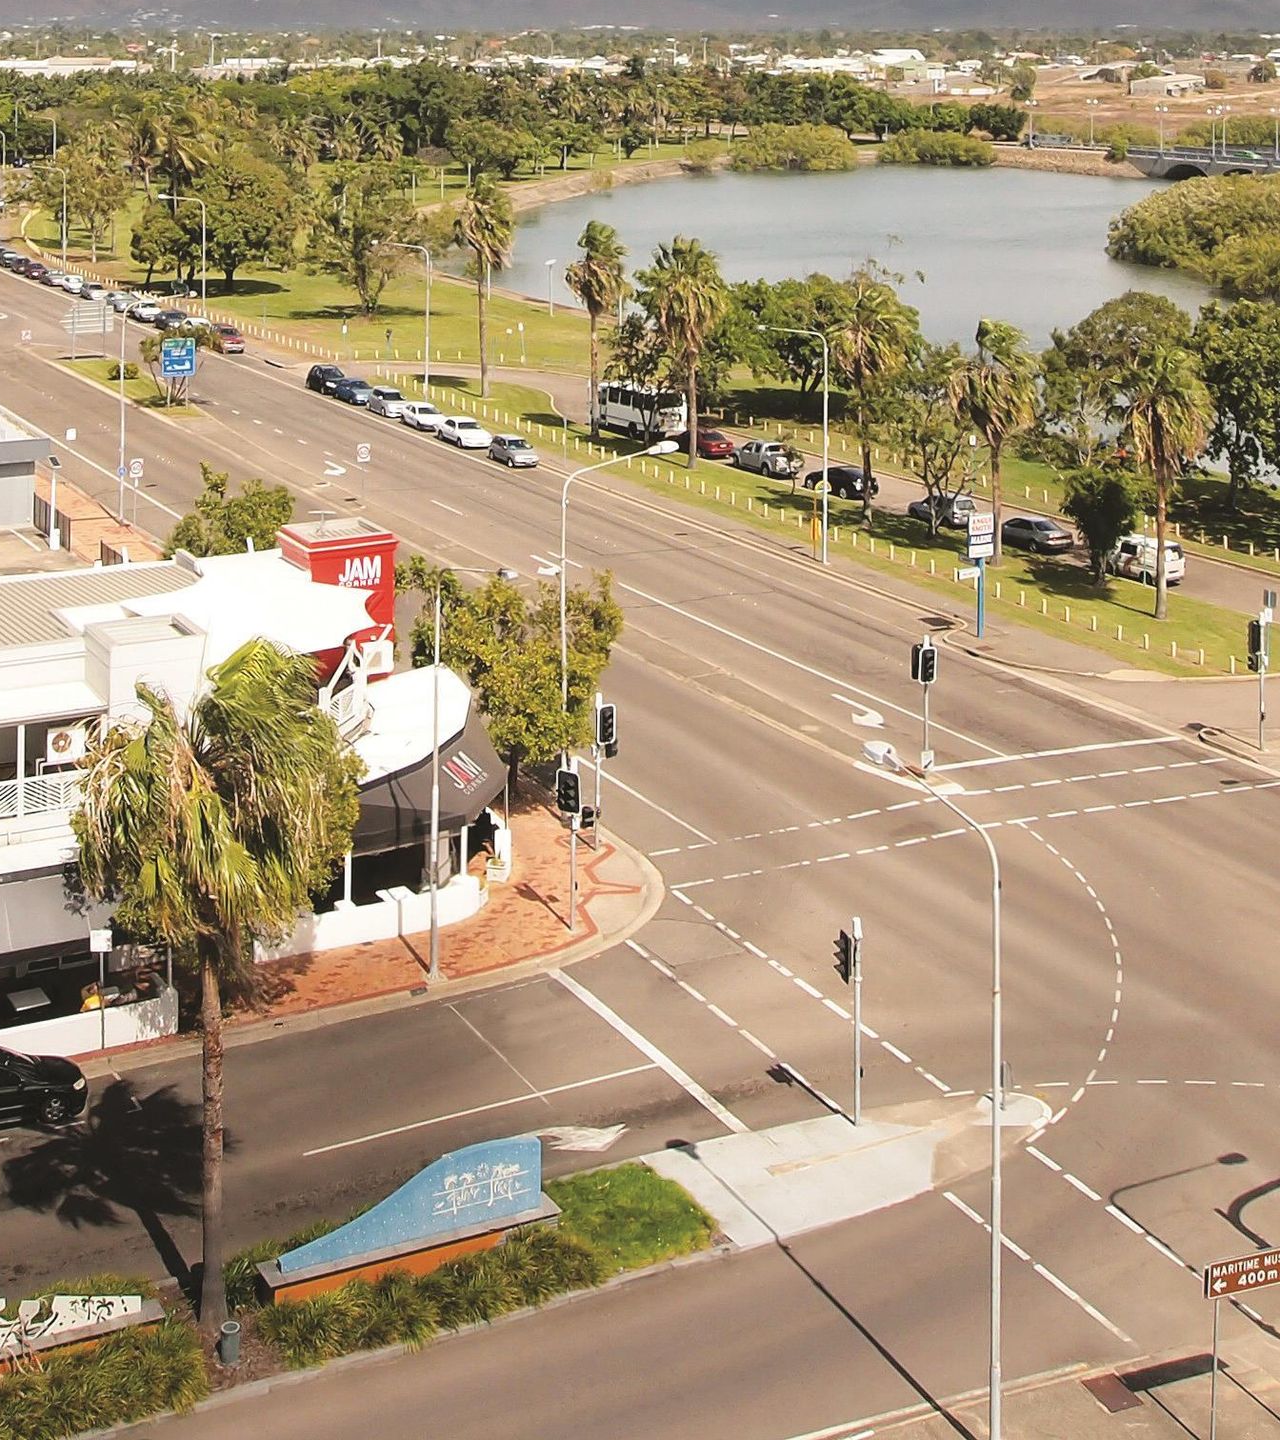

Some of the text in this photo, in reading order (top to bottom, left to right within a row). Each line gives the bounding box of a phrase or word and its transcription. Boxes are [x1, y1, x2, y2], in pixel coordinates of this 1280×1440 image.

[338, 555, 381, 583] JAM
[338, 578, 380, 588] CORNER
[441, 750, 483, 789] JAM
[463, 771, 488, 795] CORNER
[1213, 1258, 1260, 1278] MARITIME
